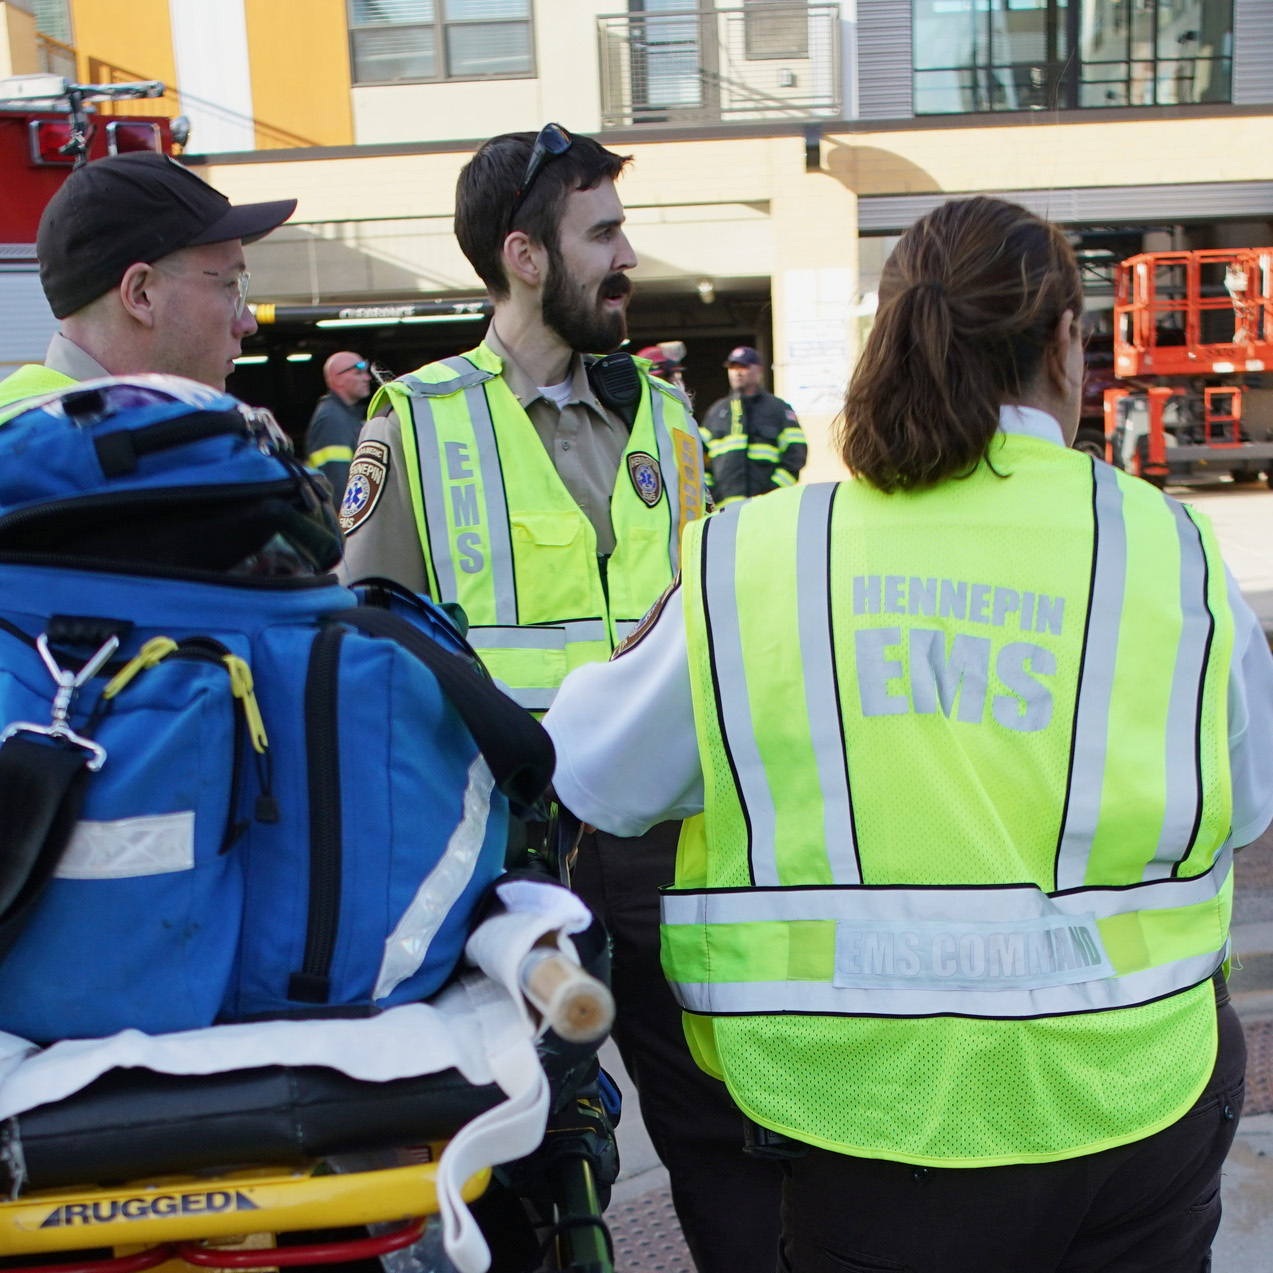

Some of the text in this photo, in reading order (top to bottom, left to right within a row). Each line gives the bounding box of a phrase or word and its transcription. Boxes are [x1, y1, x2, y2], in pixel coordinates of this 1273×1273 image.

[444, 441, 485, 574] EMS
[852, 575, 1066, 636] HENNEPIN
[854, 626, 1057, 733] EMS
[839, 925, 1102, 979] EMS COMMAND
[64, 1191, 232, 1226] RUGGED
